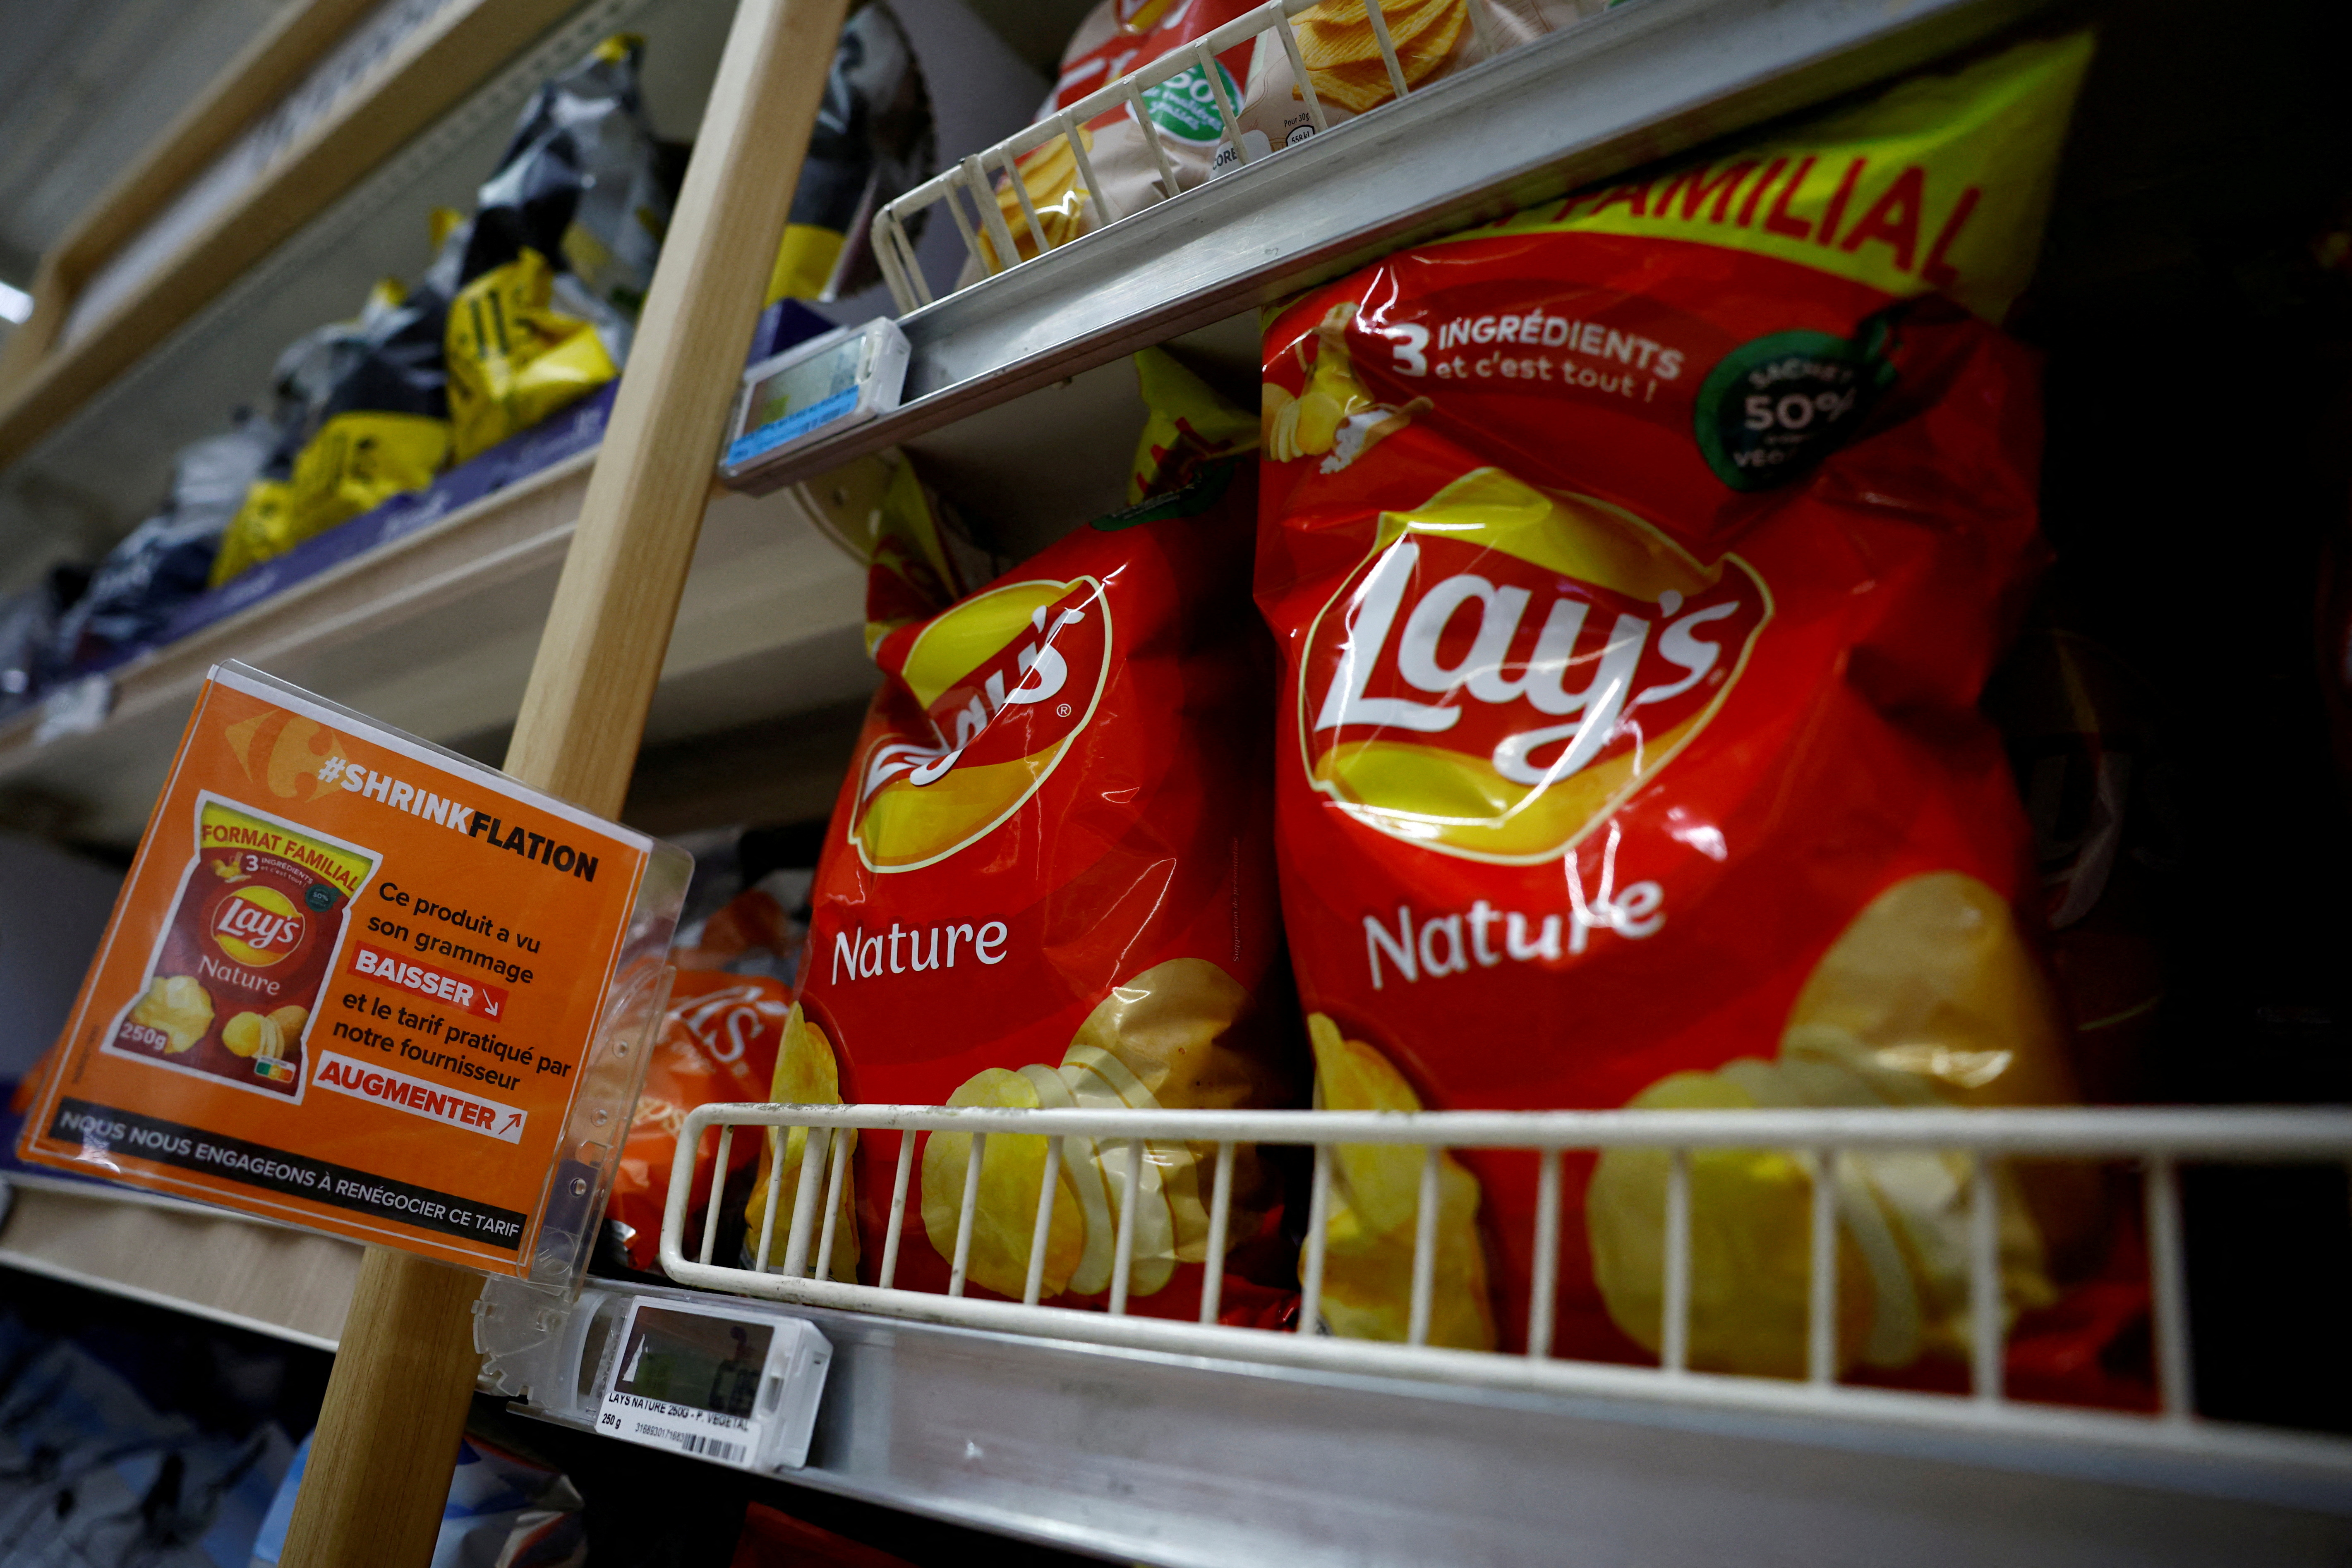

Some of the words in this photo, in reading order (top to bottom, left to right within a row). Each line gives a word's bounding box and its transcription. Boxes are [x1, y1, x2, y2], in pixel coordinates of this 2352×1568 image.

[1284, 117, 1297, 127] Pour
[1388, 323, 1429, 377] 3
[1438, 308, 1685, 381] INGRÉDIENTS
[1435, 354, 1468, 379] et
[1475, 350, 1553, 381] c'est
[1563, 359, 1635, 398] tout
[1315, 542, 1741, 786] Lay's
[318, 756, 599, 882] #SHRINKFLATION
[202, 825, 282, 851] FORMAT
[284, 840, 358, 892] FAMILIAL
[246, 855, 259, 871] 3
[217, 898, 299, 948] Lay's
[367, 915, 409, 942] son
[415, 931, 534, 984] grammage
[379, 882, 410, 907] Ce
[414, 893, 493, 937] produit
[496, 926, 510, 941] a
[516, 932, 541, 954] vu
[1362, 879, 1665, 991] Nature
[198, 955, 281, 996] Nature
[355, 949, 474, 1007] BAISSER
[832, 920, 1008, 986] Nature
[119, 1021, 166, 1050] 250g
[333, 1022, 395, 1052] notre
[400, 1040, 521, 1091] fournisseur
[342, 993, 367, 1013] et
[371, 996, 392, 1020] le
[398, 1005, 444, 1037] tarif
[445, 1026, 534, 1067] pratiqué
[536, 1054, 572, 1078] par
[317, 1060, 496, 1131] AUGMENTER
[60, 1111, 127, 1142] NOUS
[129, 1129, 191, 1156] NOUS
[194, 1142, 317, 1187] ENGAGEONS
[318, 1171, 332, 1191] À
[335, 1178, 446, 1220] RENÉGOCIER
[449, 1208, 472, 1226] CE
[475, 1215, 520, 1239] TARIF
[602, 1413, 615, 1426] 250
[615, 1417, 621, 1429] g
[609, 1393, 631, 1406] LAYS
[632, 1398, 666, 1414] NATURE
